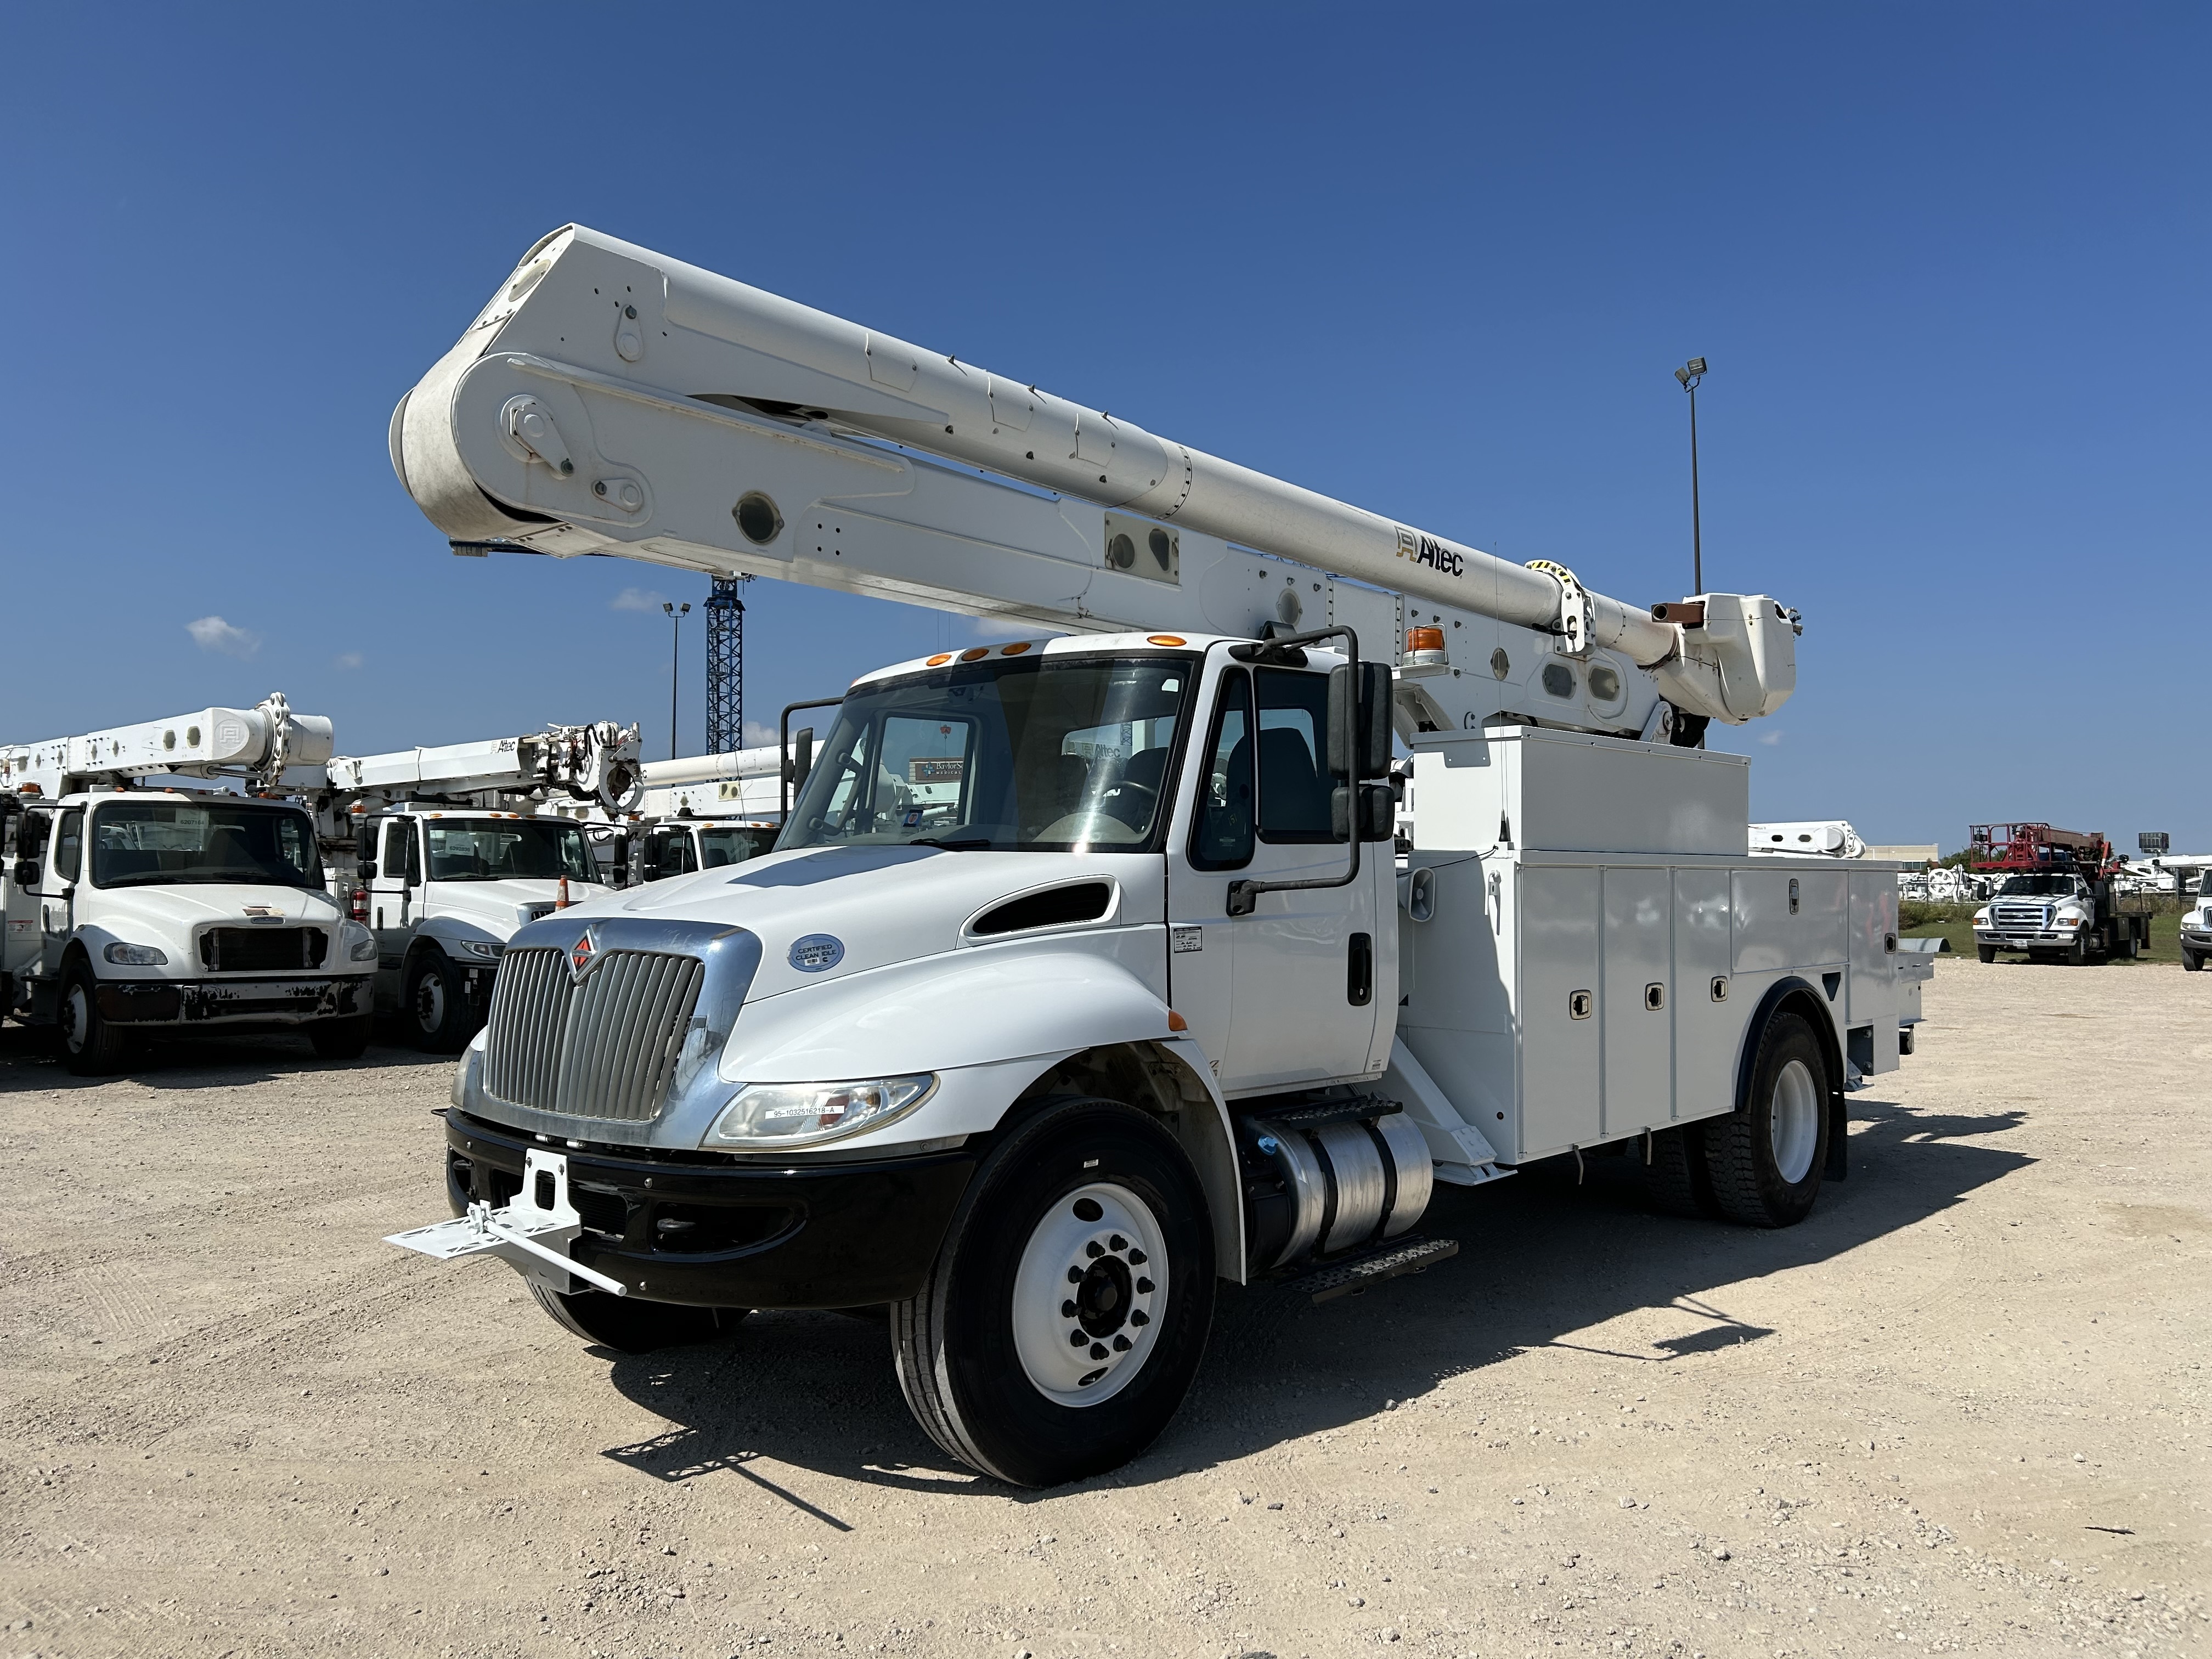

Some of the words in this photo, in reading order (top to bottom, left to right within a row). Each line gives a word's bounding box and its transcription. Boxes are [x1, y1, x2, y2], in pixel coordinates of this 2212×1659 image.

[1416, 535, 1464, 577] Altec
[498, 740, 515, 753] Altec
[1094, 743, 1121, 760] Altec
[798, 944, 833, 953] CERTIFIED
[795, 952, 819, 961] CLEAN
[774, 1107, 835, 1118] 95-1032516218-A
